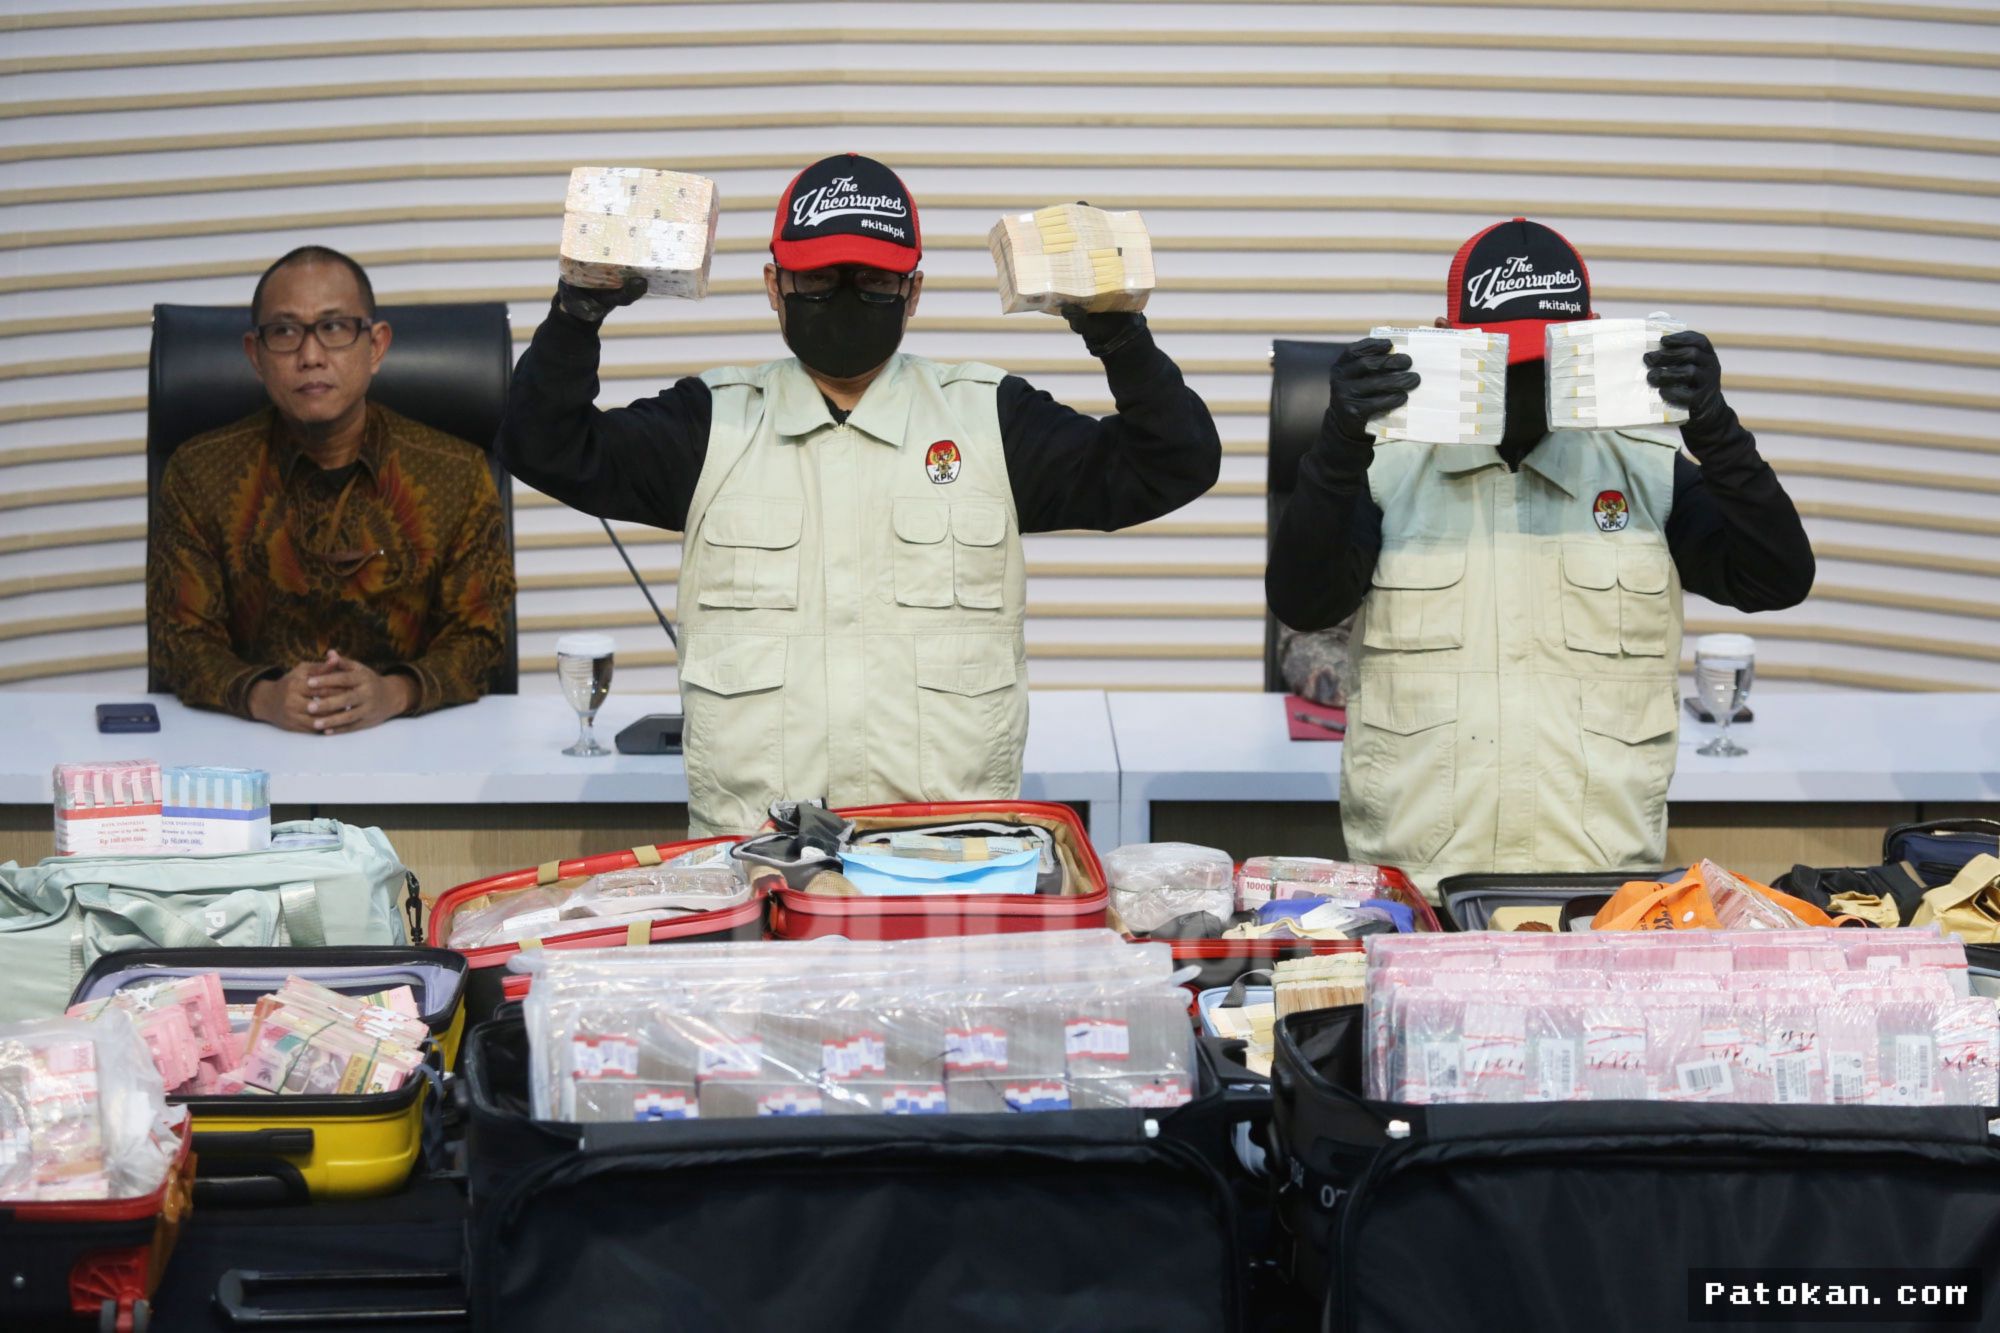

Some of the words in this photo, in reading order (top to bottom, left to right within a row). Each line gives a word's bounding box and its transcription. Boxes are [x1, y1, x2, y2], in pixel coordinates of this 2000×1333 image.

[826, 176, 858, 198] The
[793, 187, 907, 226] Uncorrupted
[860, 218, 905, 239] #kitakpk
[1502, 256, 1533, 279] The
[1467, 266, 1581, 308] Uncorrupted
[1538, 300, 1582, 314] #kitakpk
[933, 472, 954, 482] KPK
[1601, 521, 1622, 529] KPK
